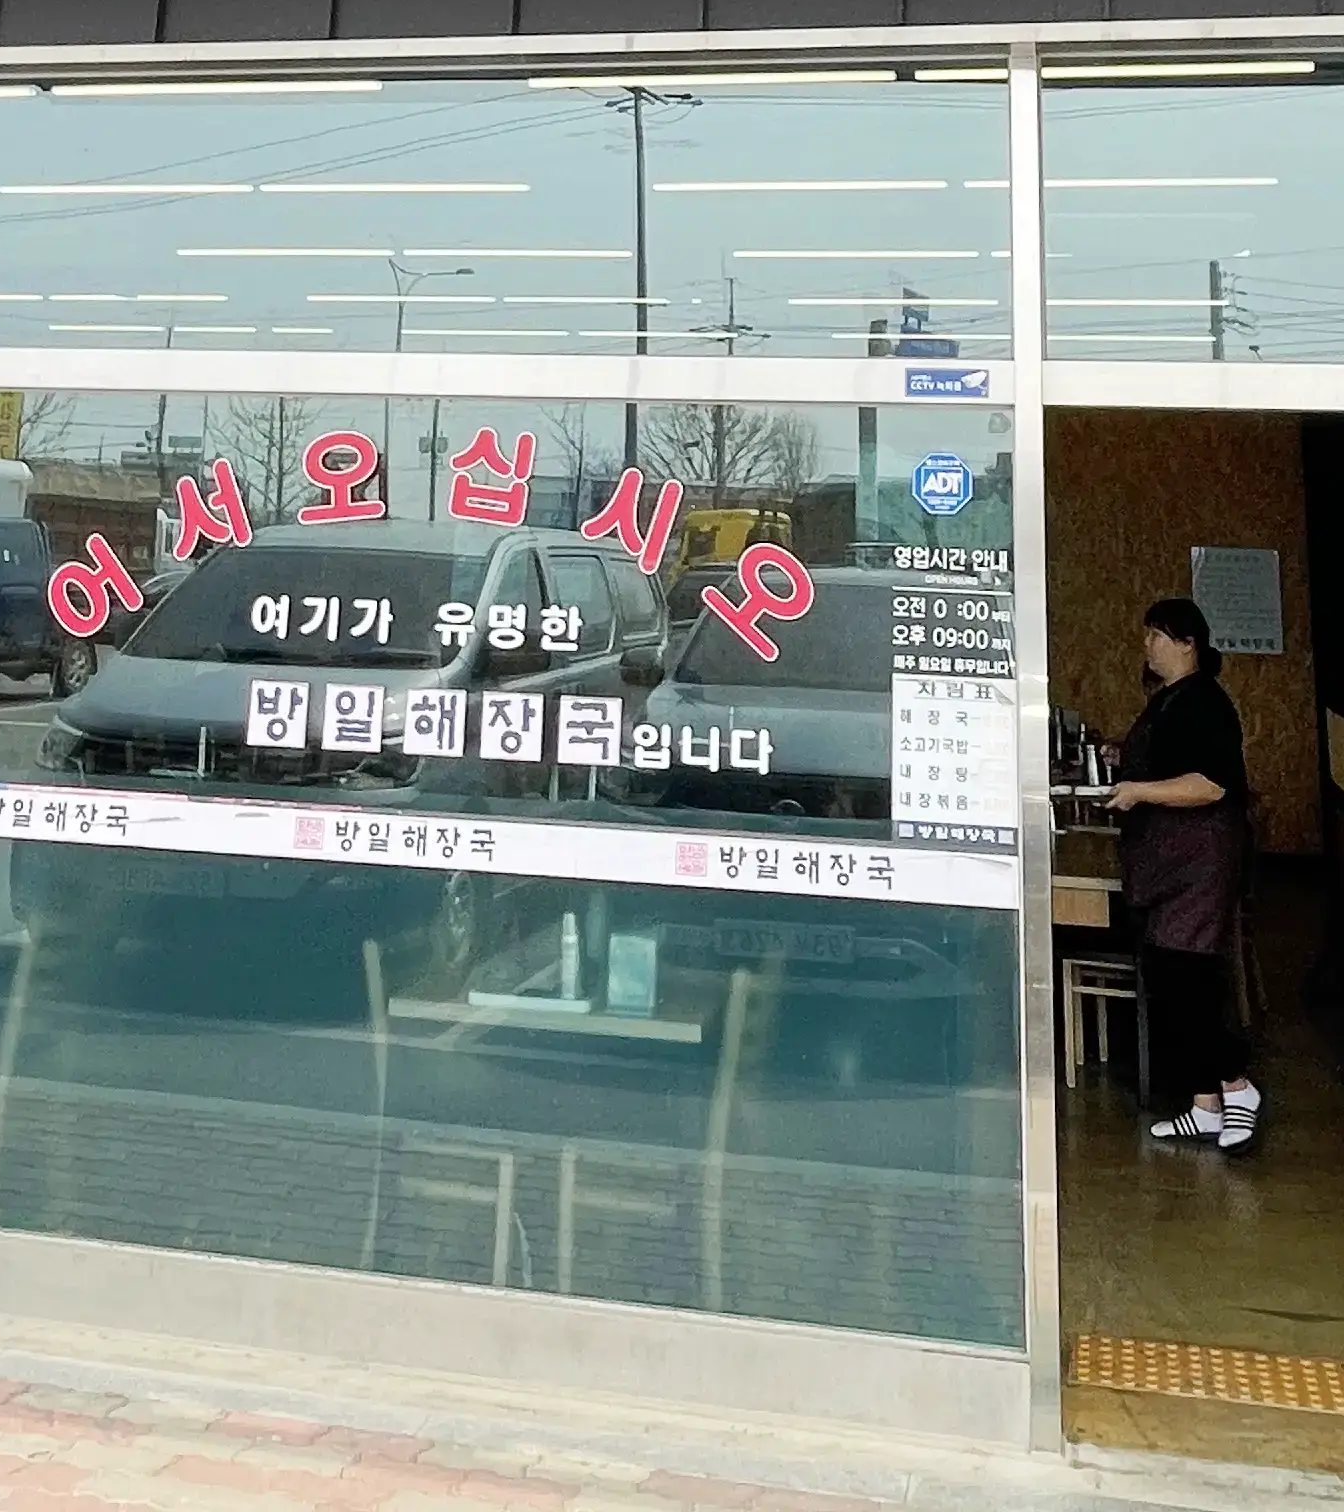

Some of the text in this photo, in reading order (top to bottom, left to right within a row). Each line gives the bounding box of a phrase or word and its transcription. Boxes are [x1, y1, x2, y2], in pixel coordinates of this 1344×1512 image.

[910, 380, 934, 391] CCTV
[923, 472, 963, 495] ADT
[47, 425, 816, 663] 어서오십시오
[894, 546, 1008, 572] 영업시간 안내
[250, 594, 584, 651] 여기가 유명한
[892, 596, 926, 619] 오전
[991, 610, 1011, 623] 부터
[892, 624, 926, 646] 오후
[932, 626, 989, 650] 09:00
[894, 654, 916, 669] 매주
[918, 656, 952, 672] 일요일
[900, 736, 968, 754] 소고기국밥
[334, 819, 497, 862] 방일해장국
[918, 825, 995, 843] 방일해장국
[719, 845, 895, 890] 방일해장국
